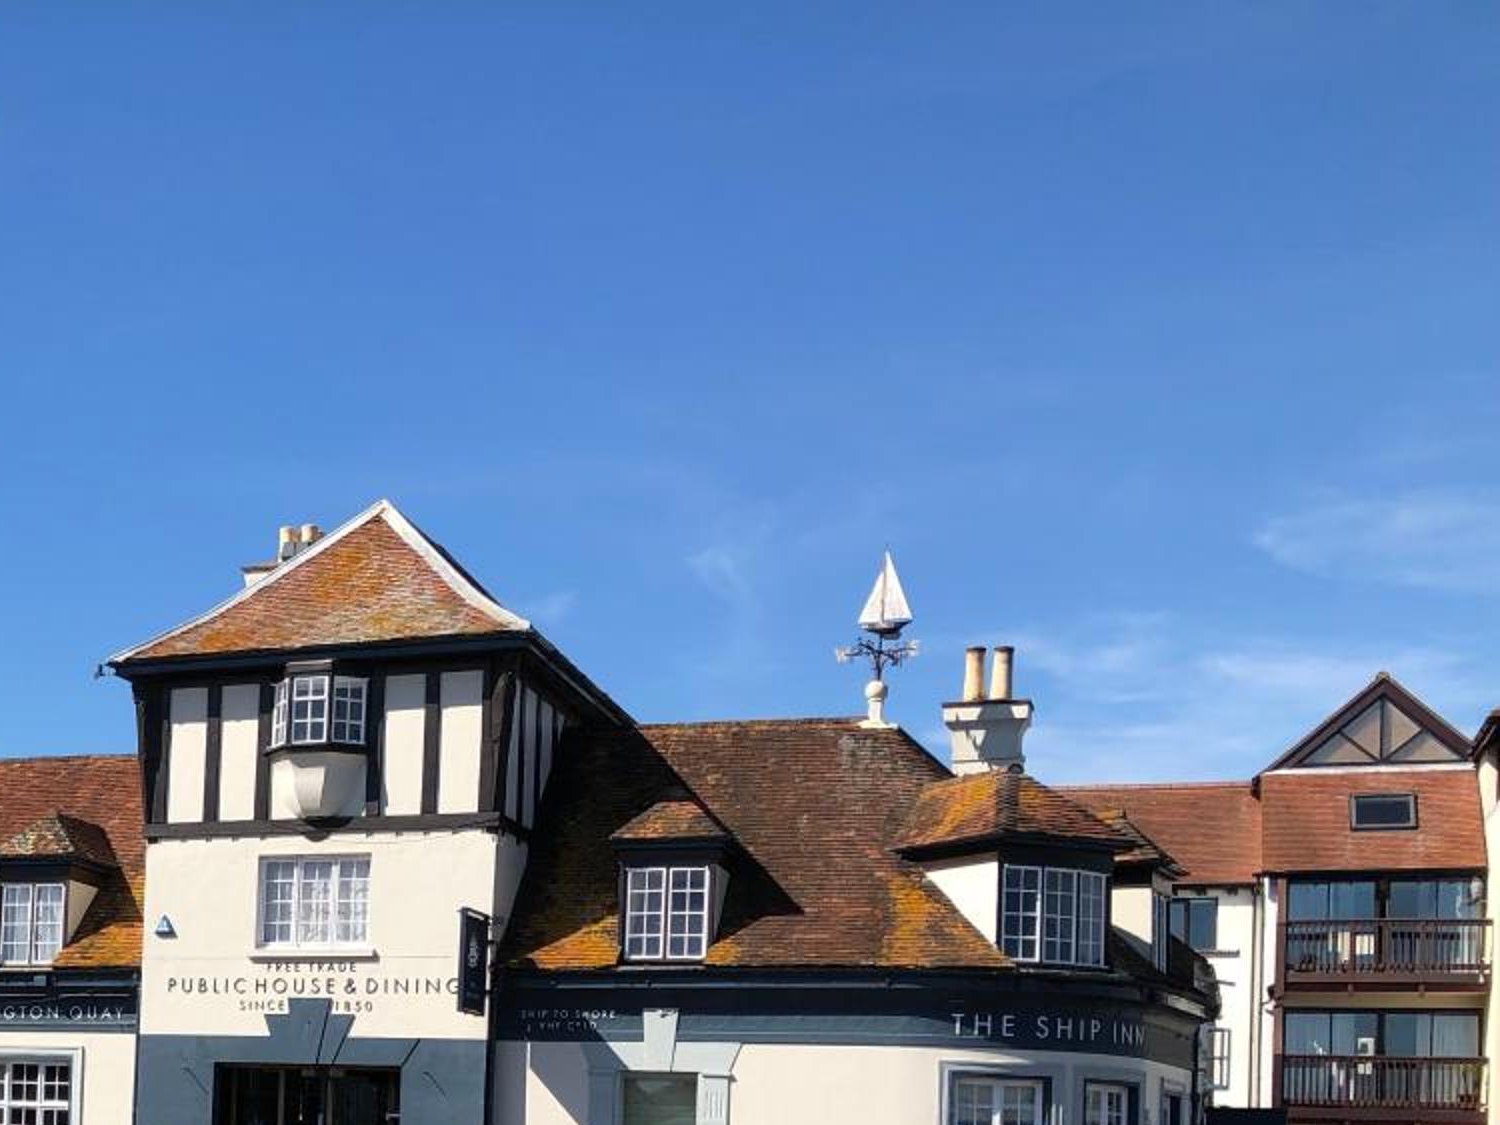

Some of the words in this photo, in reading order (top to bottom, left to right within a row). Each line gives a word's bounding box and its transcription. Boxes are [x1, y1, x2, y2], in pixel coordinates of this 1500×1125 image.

[167, 977, 246, 994] PUBLIC
[255, 977, 335, 994] HOUSE
[343, 978, 357, 994] &
[366, 978, 459, 994] DINING
[69, 1005, 123, 1020] QUAY
[239, 1000, 285, 1011] SINCE
[335, 1001, 373, 1012] 1850
[951, 1013, 1016, 1037] THE
[1036, 1016, 1101, 1040] SHIP
[1113, 1021, 1146, 1046] INN
